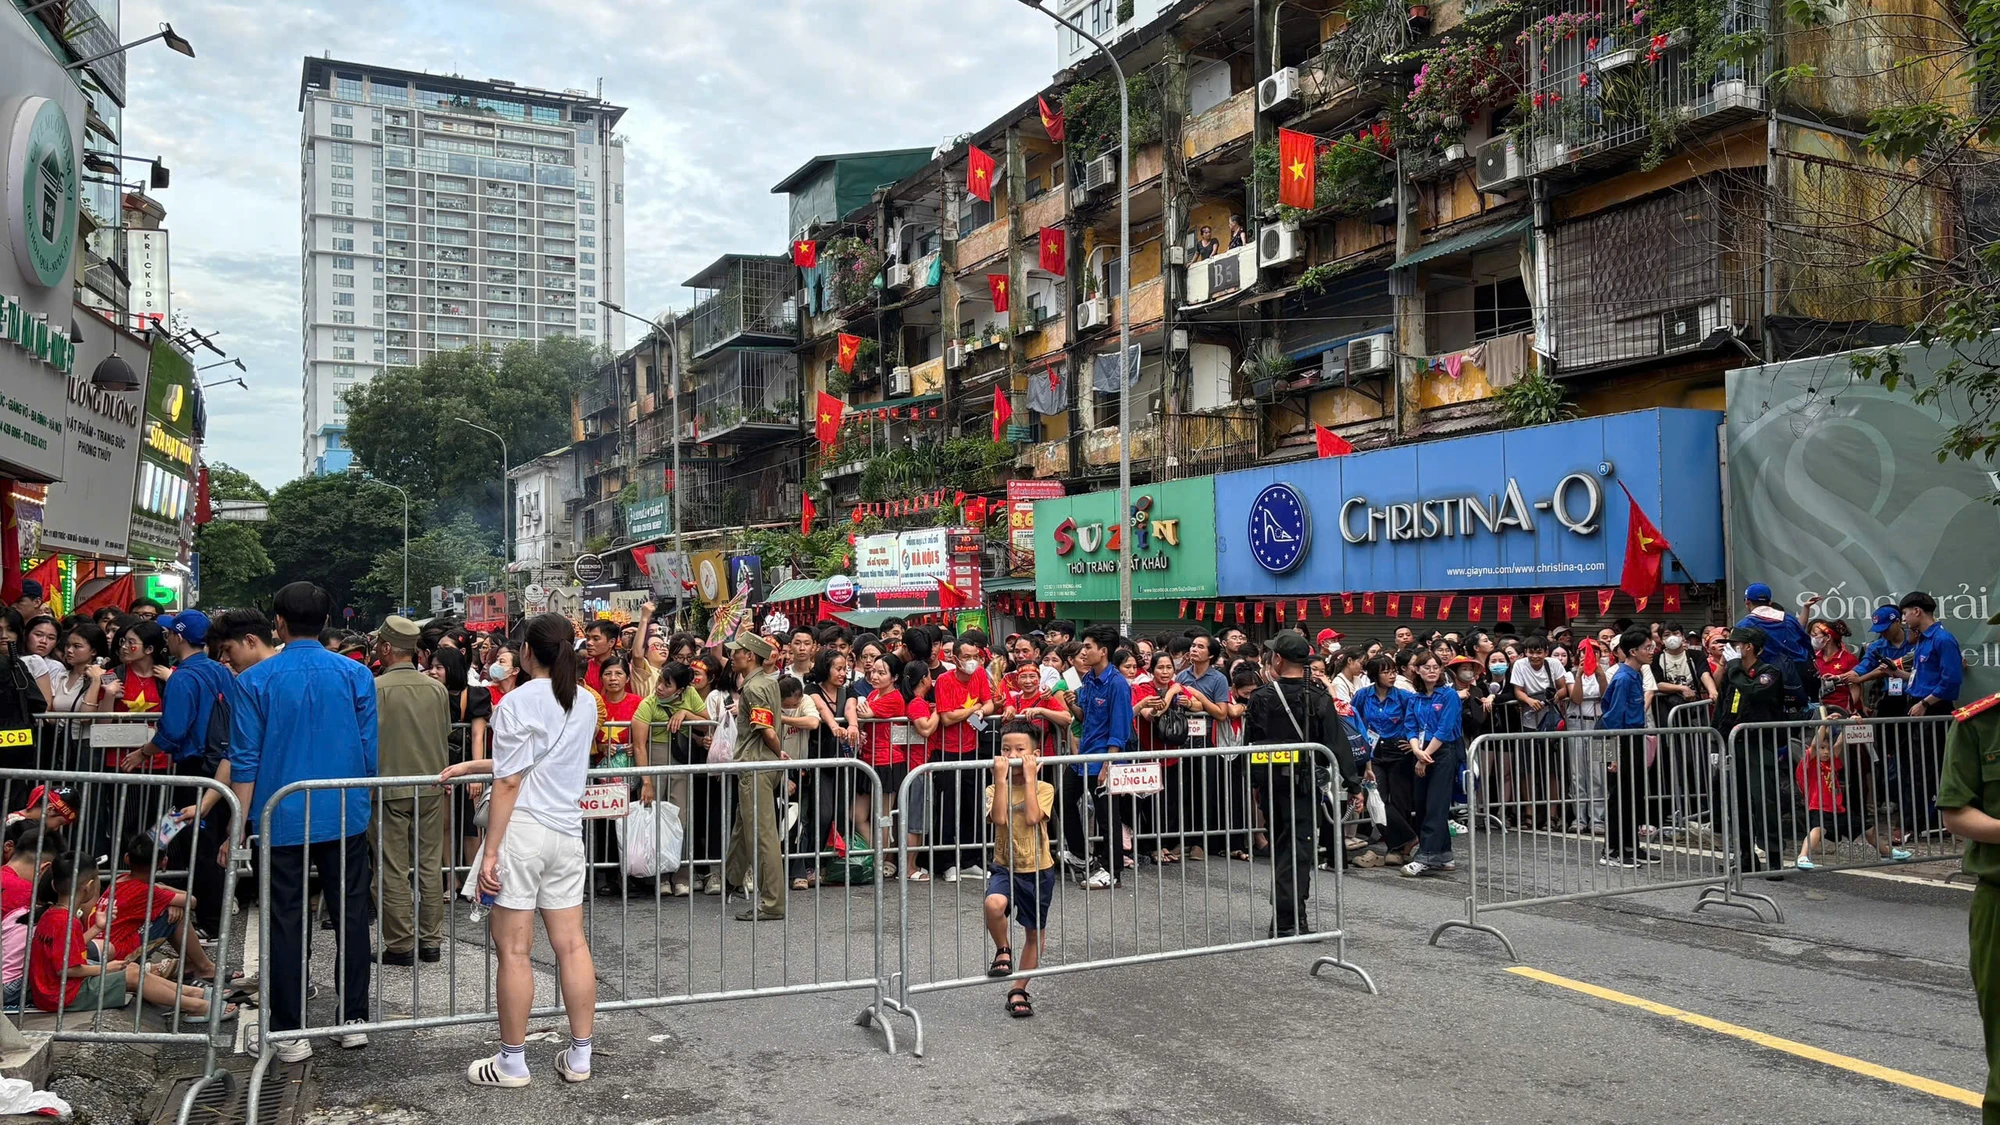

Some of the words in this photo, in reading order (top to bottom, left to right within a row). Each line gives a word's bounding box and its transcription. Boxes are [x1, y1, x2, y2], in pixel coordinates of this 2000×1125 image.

[144, 233, 152, 307] KRICKIDS
[101, 392, 137, 428] DƯƠNG
[911, 548, 921, 566] HÀ
[921, 547, 935, 568] NỘI
[1066, 558, 1085, 574] THỜI
[1086, 560, 1115, 573] TRANG
[1142, 549, 1168, 569] KHẨU
[1446, 561, 1605, 578] www.giaynu.com/www.christina-q.com
[1123, 766, 1147, 774] C.A.H.N
[1113, 774, 1140, 787] DỪNG
[578, 800, 599, 811] NG
[601, 798, 624, 811] LẠI
